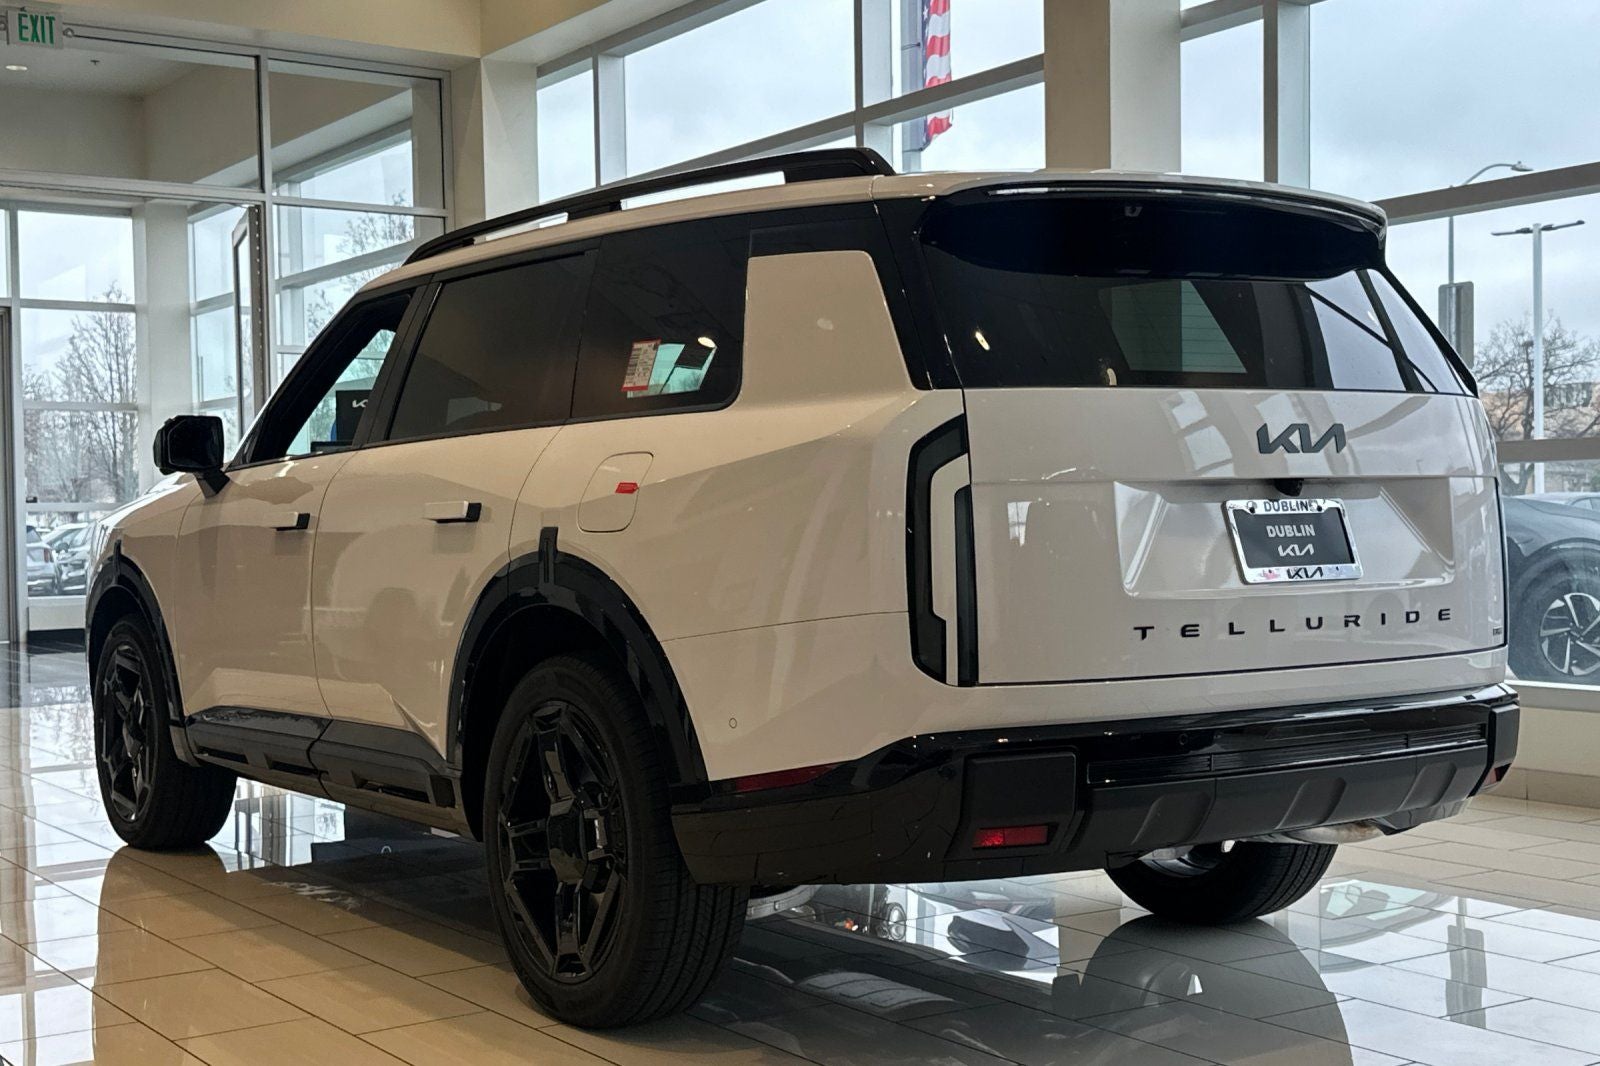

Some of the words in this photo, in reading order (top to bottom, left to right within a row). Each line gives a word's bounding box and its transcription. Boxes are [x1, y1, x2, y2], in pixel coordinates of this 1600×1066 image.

[18, 13, 55, 44] EXIT
[1256, 423, 1346, 454] KIA
[1264, 500, 1309, 512] DUBLIN
[1266, 524, 1316, 538] DUBLIN
[1277, 543, 1315, 557] KIA
[1287, 566, 1324, 579] KIA
[1133, 608, 1451, 640] TELLURIDE
